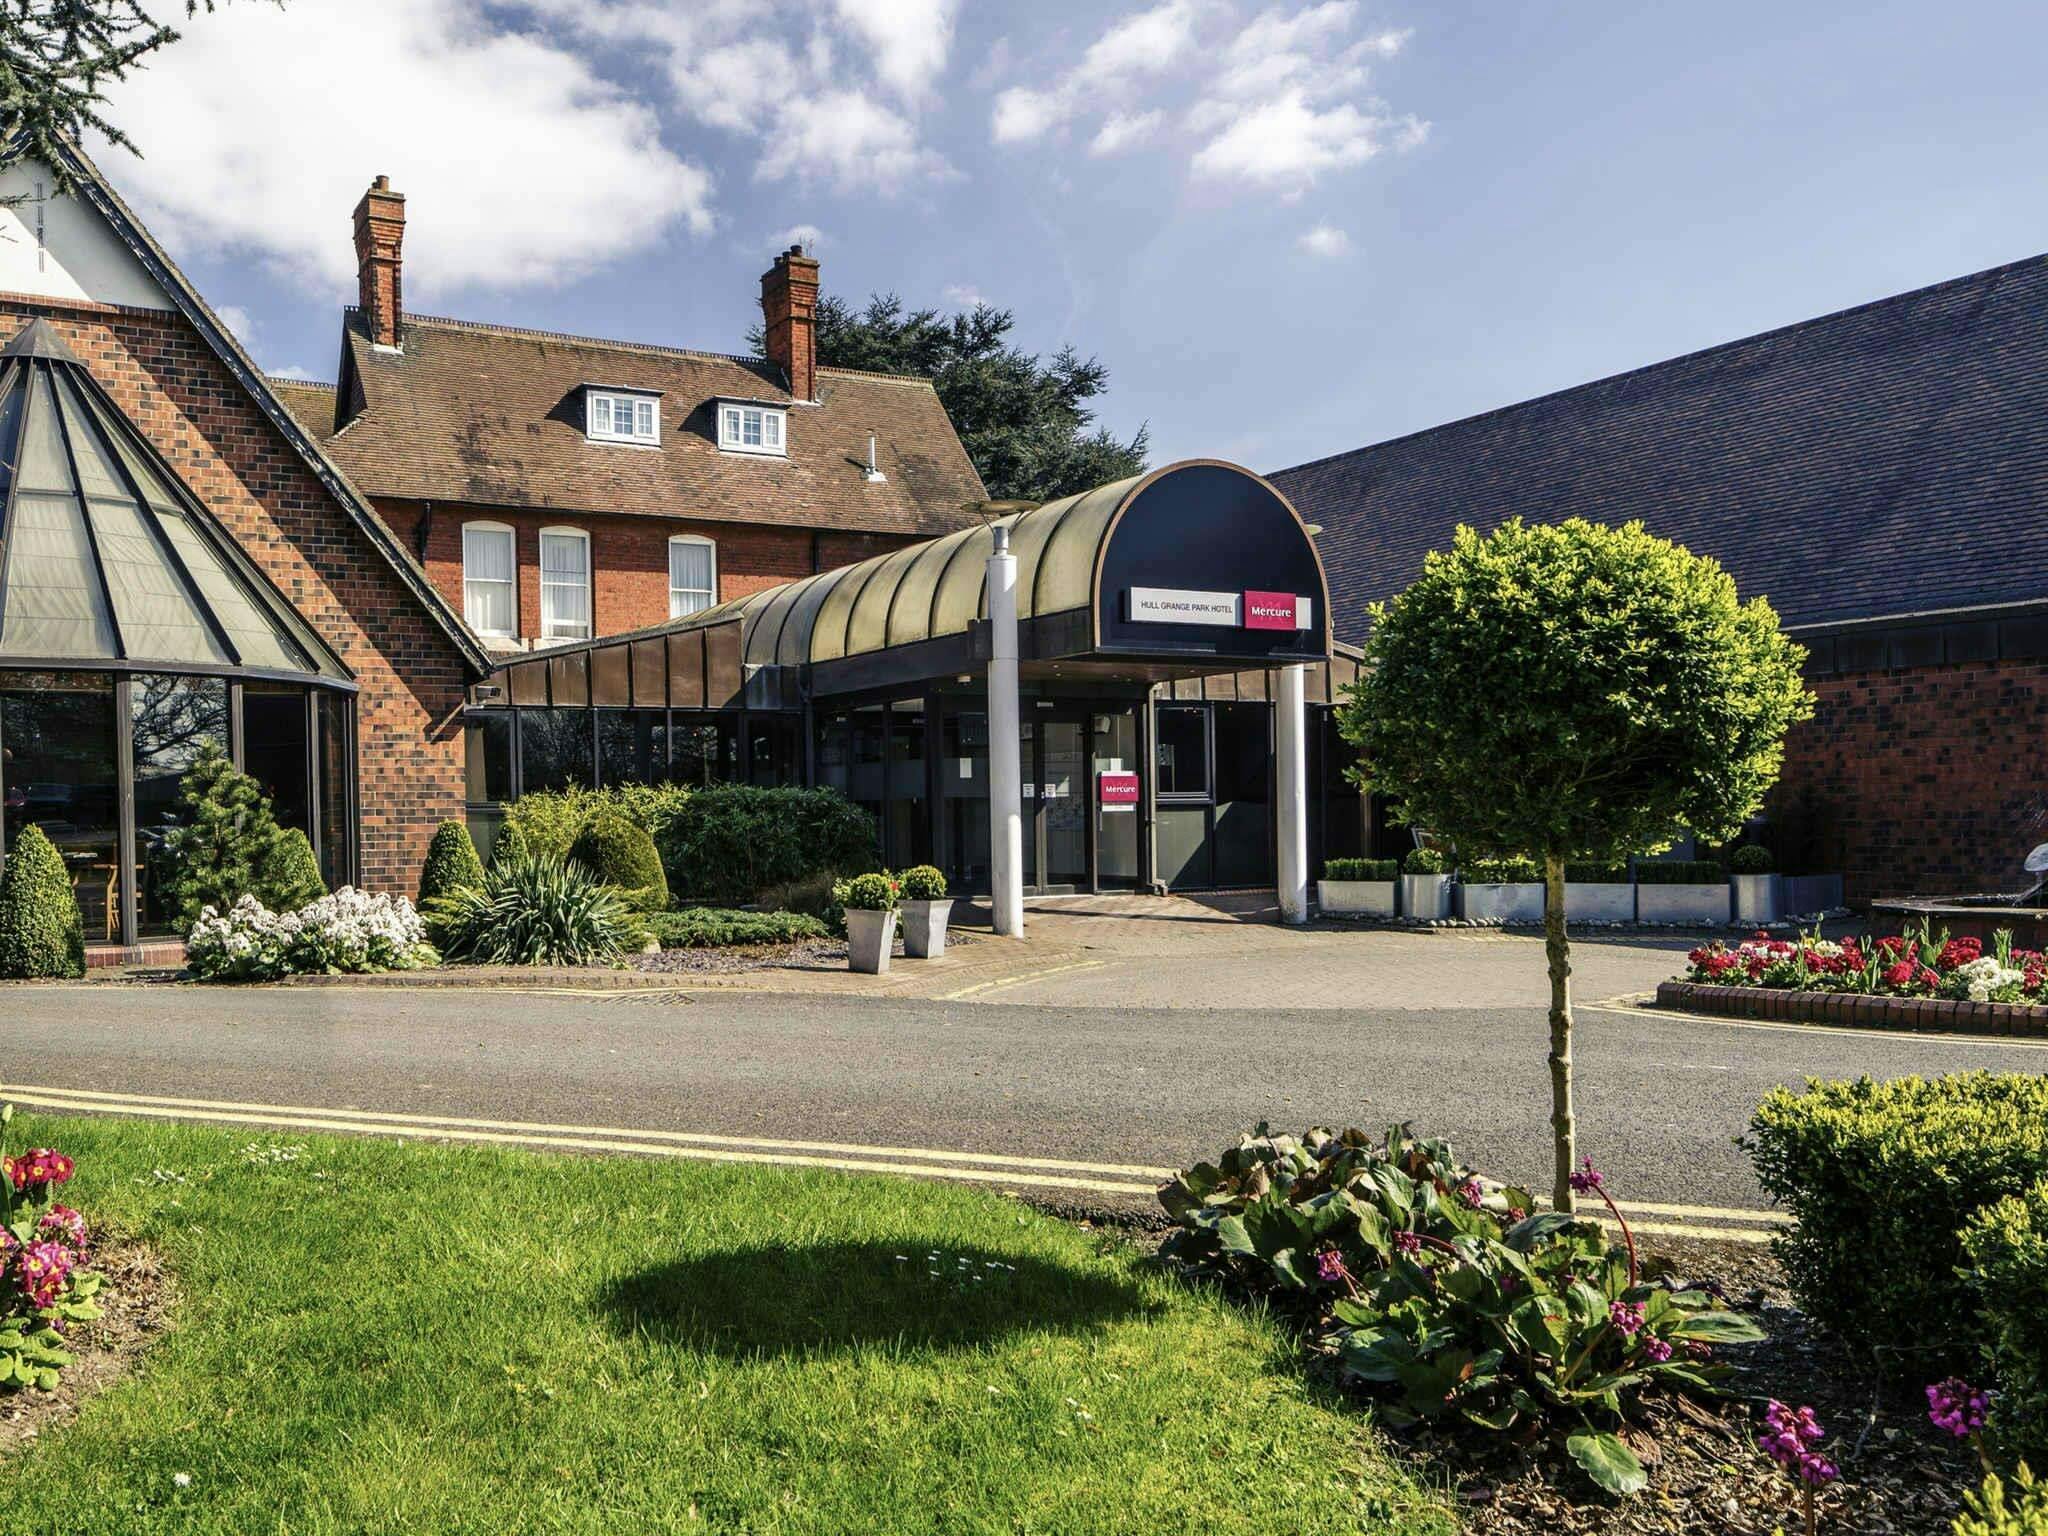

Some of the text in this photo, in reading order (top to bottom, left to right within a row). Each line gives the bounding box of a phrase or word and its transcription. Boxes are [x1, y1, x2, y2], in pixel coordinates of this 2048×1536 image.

[1141, 600, 1232, 613] HULL GRANGE PARK HOTEL
[1251, 606, 1292, 618] Mercure
[1105, 785, 1136, 793] Mercure
